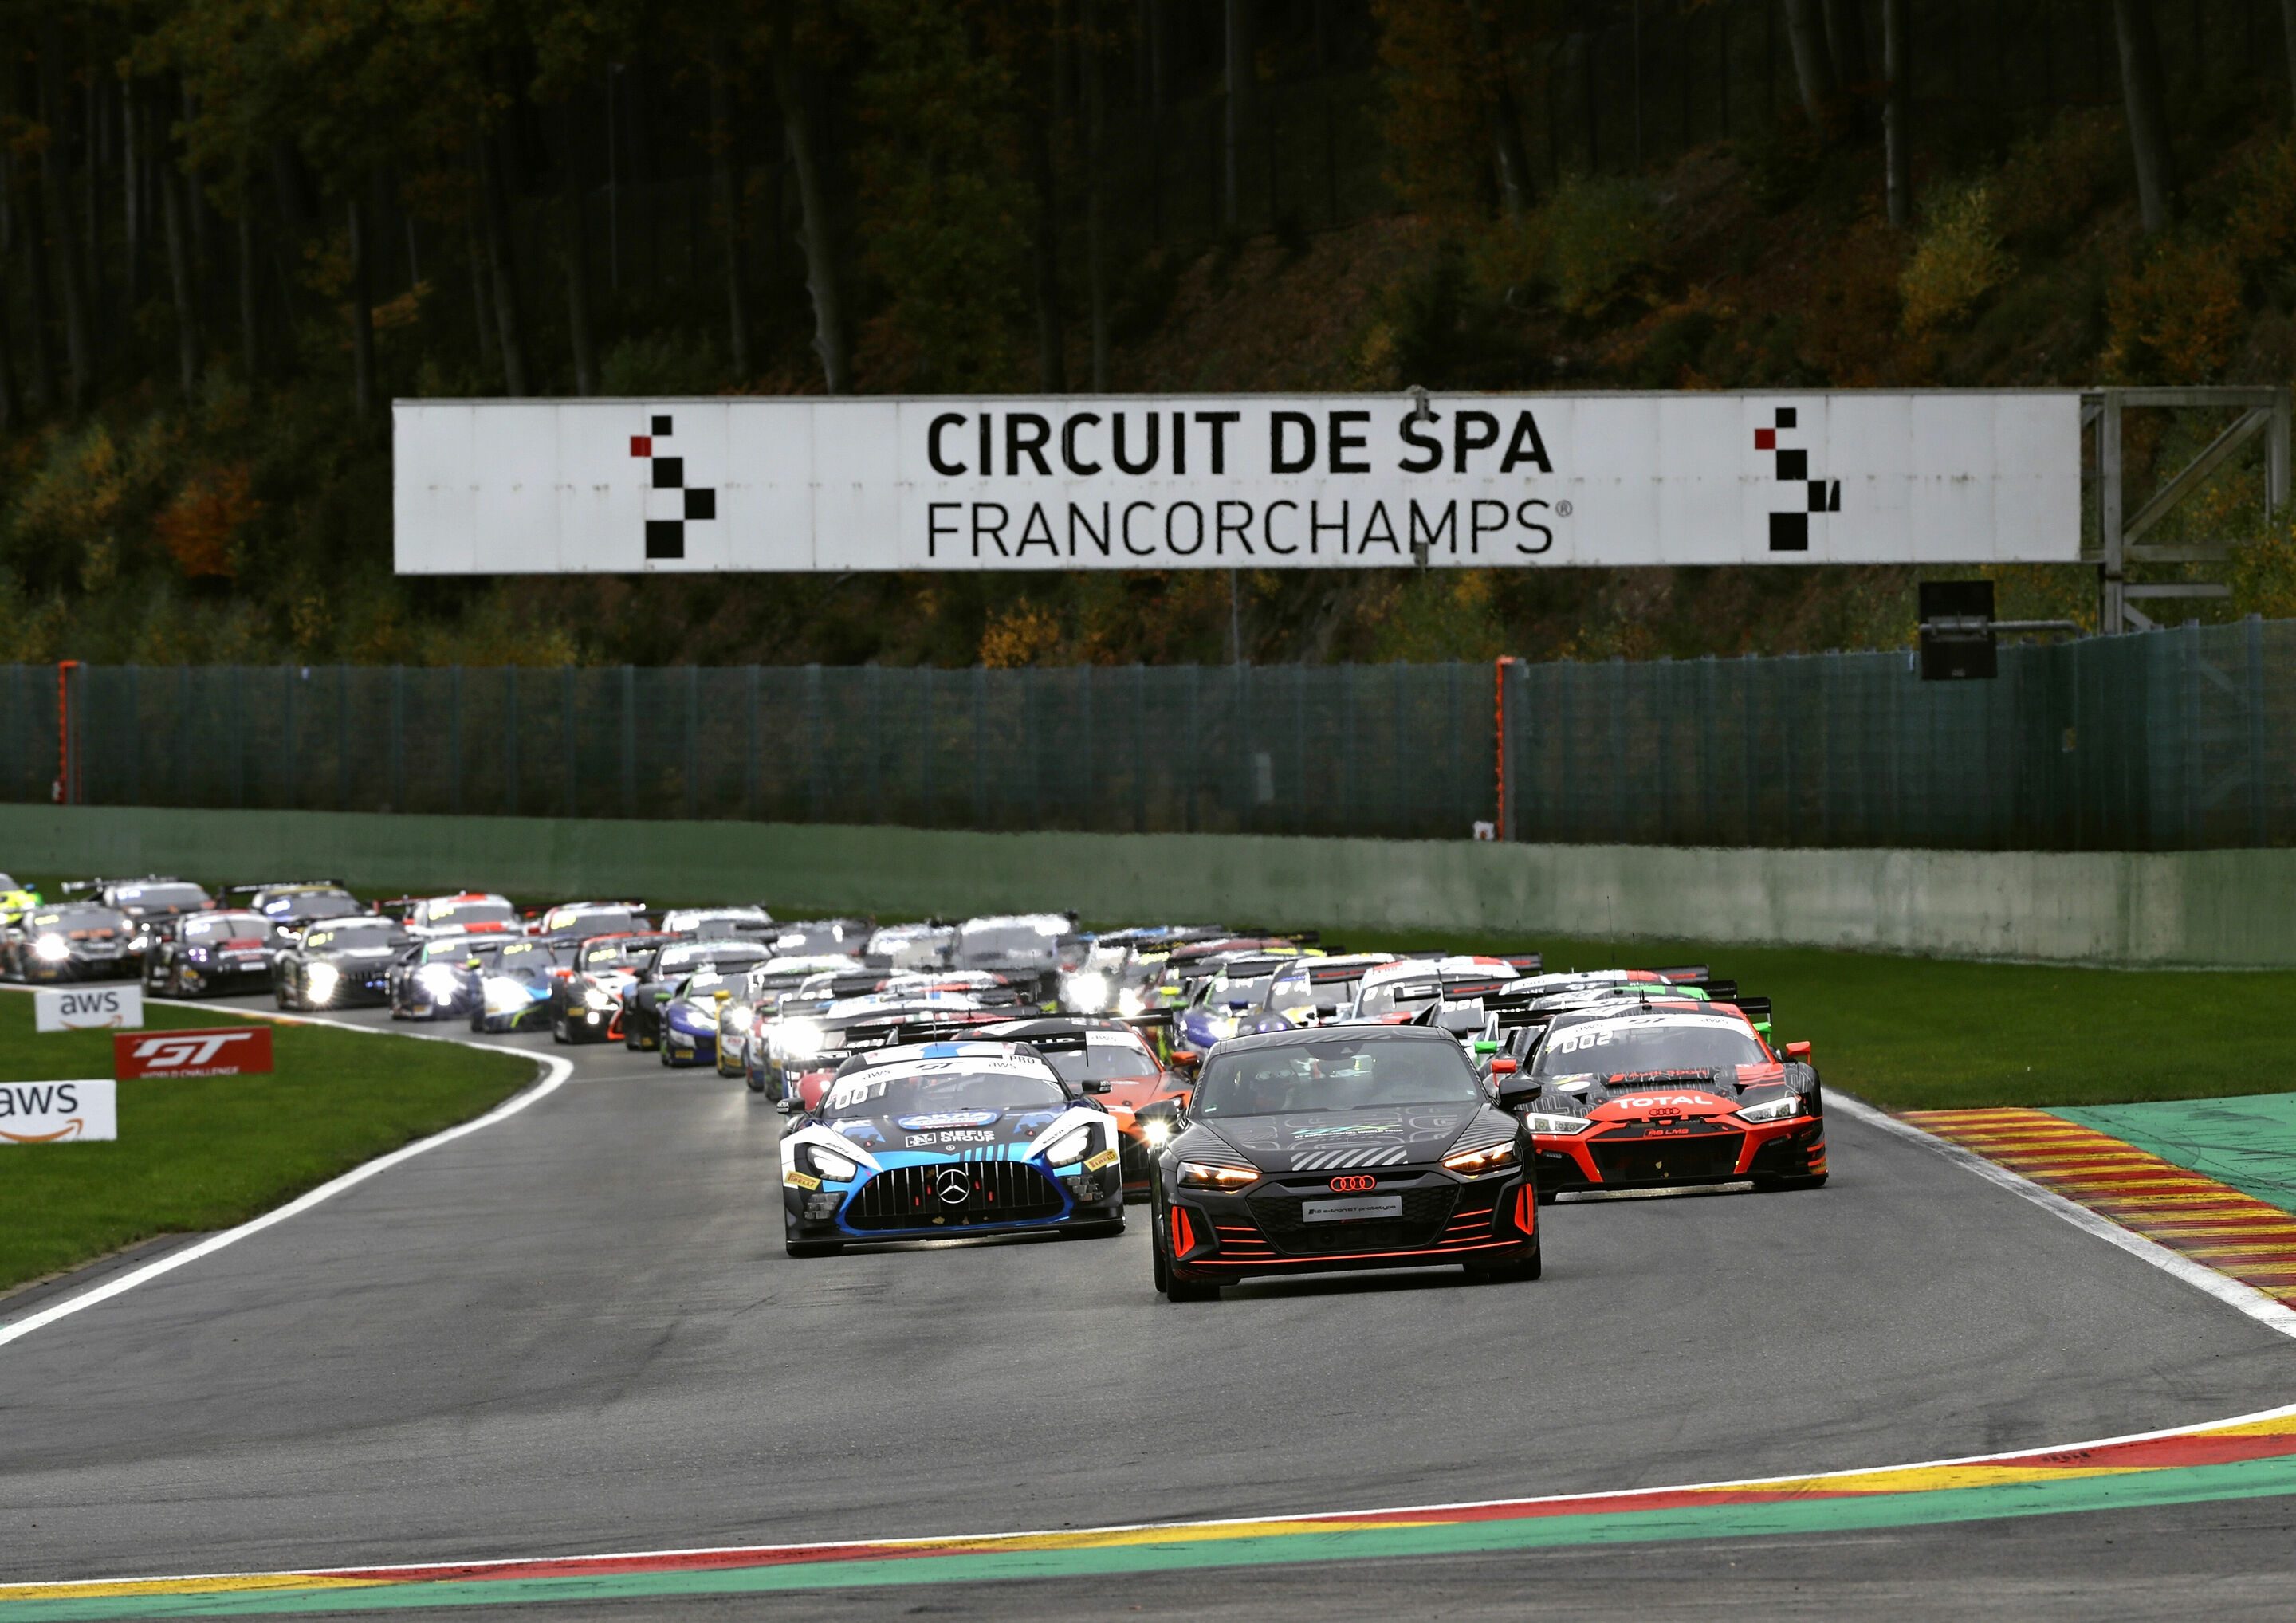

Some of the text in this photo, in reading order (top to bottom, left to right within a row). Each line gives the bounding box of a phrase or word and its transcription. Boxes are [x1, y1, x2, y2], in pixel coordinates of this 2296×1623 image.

[928, 409, 1553, 477] CIRCUIT DE SPA
[61, 992, 119, 1016] aws
[133, 1032, 253, 1068] GT
[1560, 1030, 1614, 1054] 002
[1009, 1055, 1036, 1064] PRO
[0, 1083, 78, 1116] aws
[1612, 1095, 1714, 1109] TOTAL
